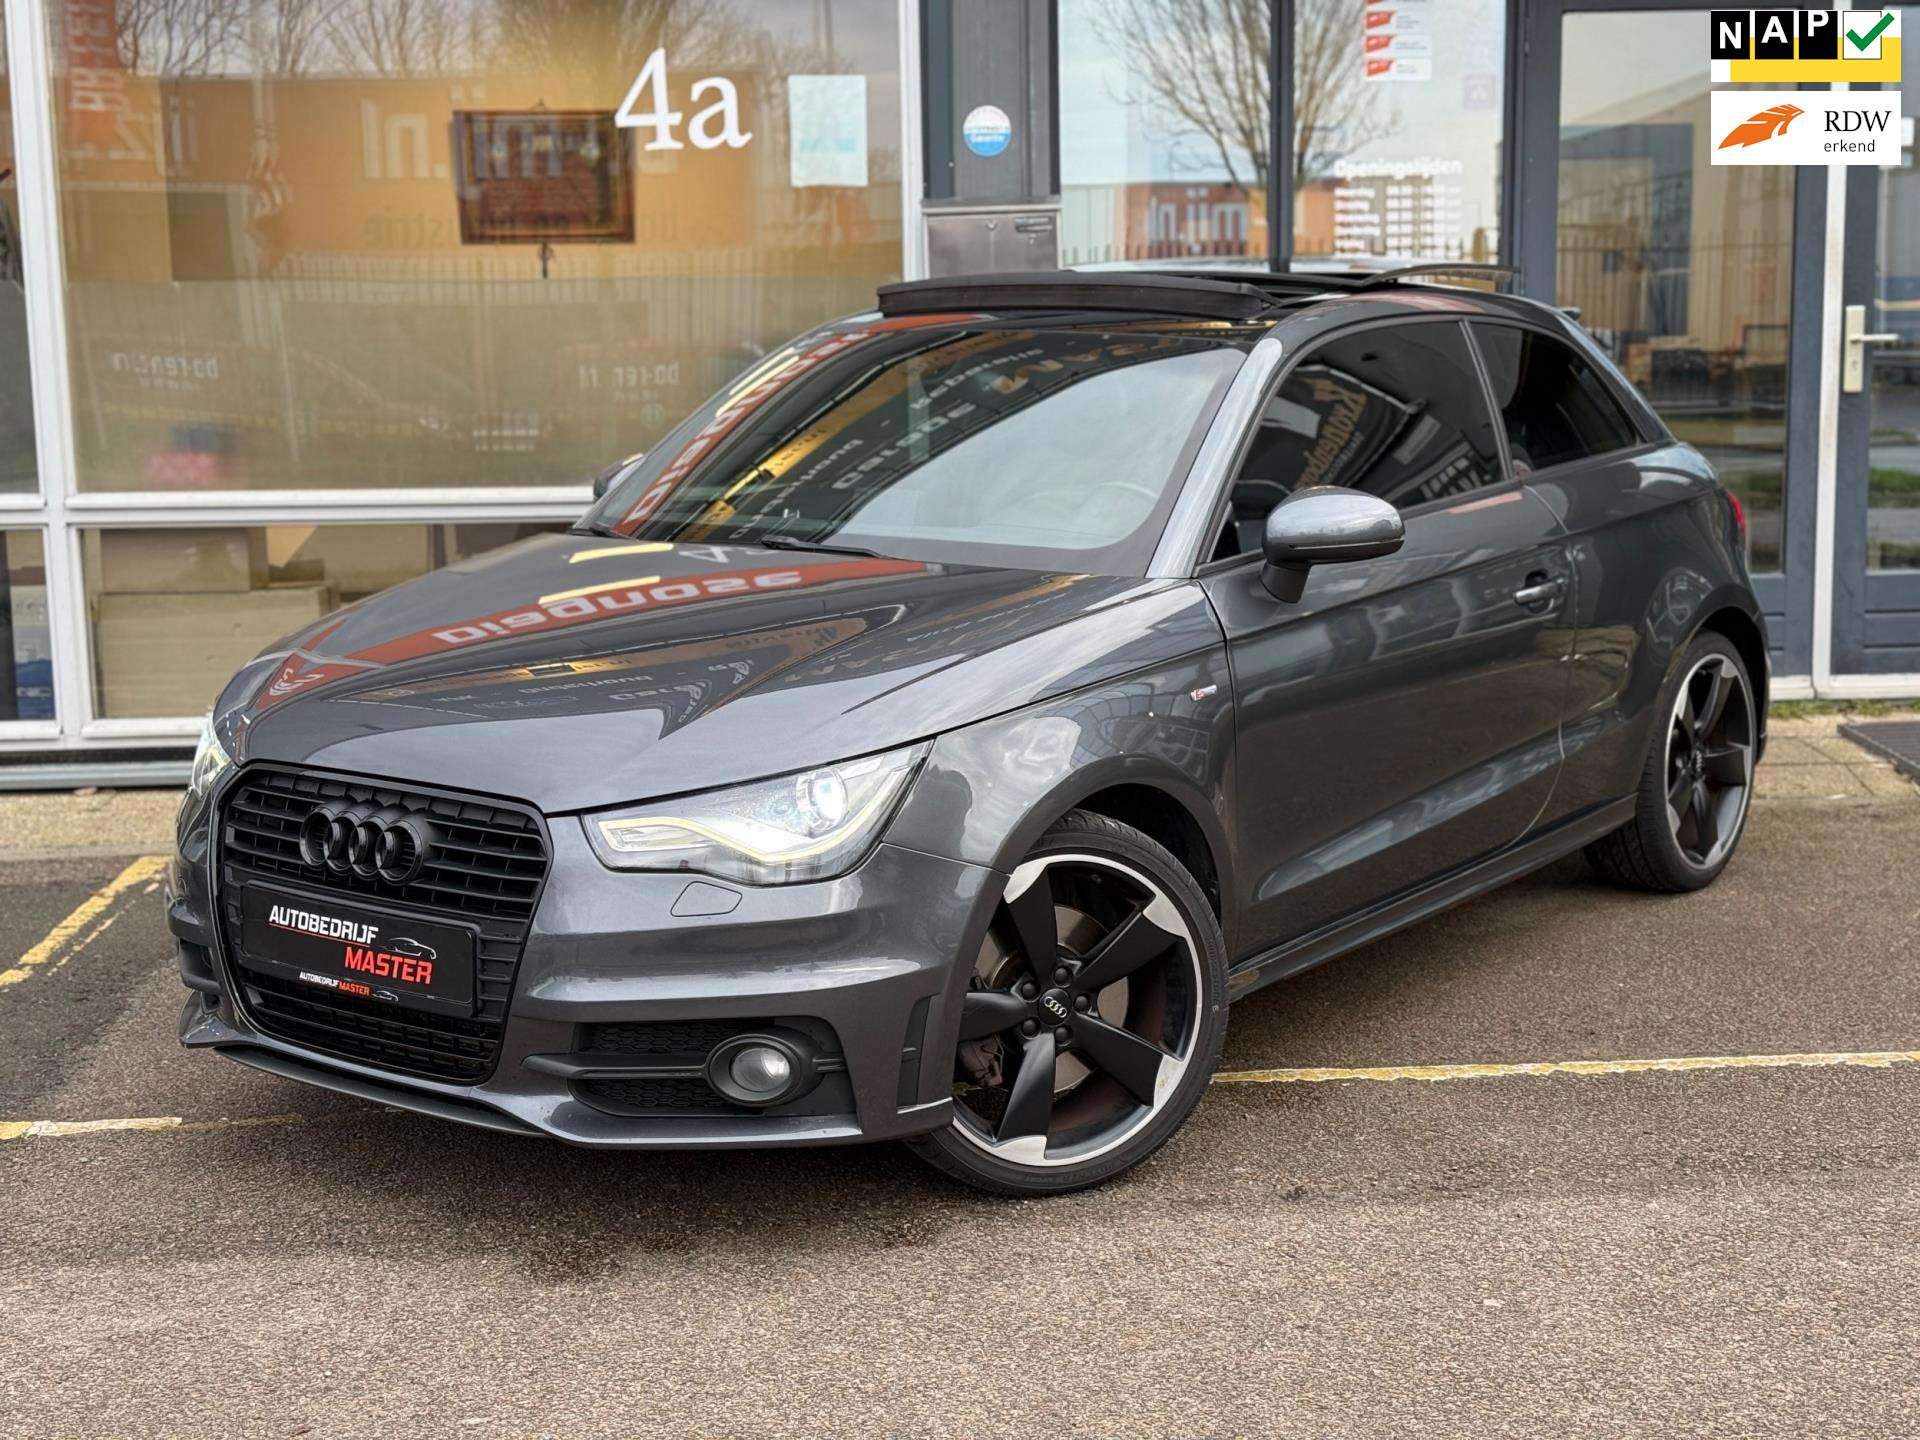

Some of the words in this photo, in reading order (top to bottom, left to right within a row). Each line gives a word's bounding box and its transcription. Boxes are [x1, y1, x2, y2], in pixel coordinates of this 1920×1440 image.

[615, 47, 753, 151] 4a
[269, 905, 379, 945] AUTOBEDRIJF
[299, 971, 340, 987] AUTOBEDRIJF
[338, 980, 370, 996] MASTER
[344, 946, 434, 985] MASTER
